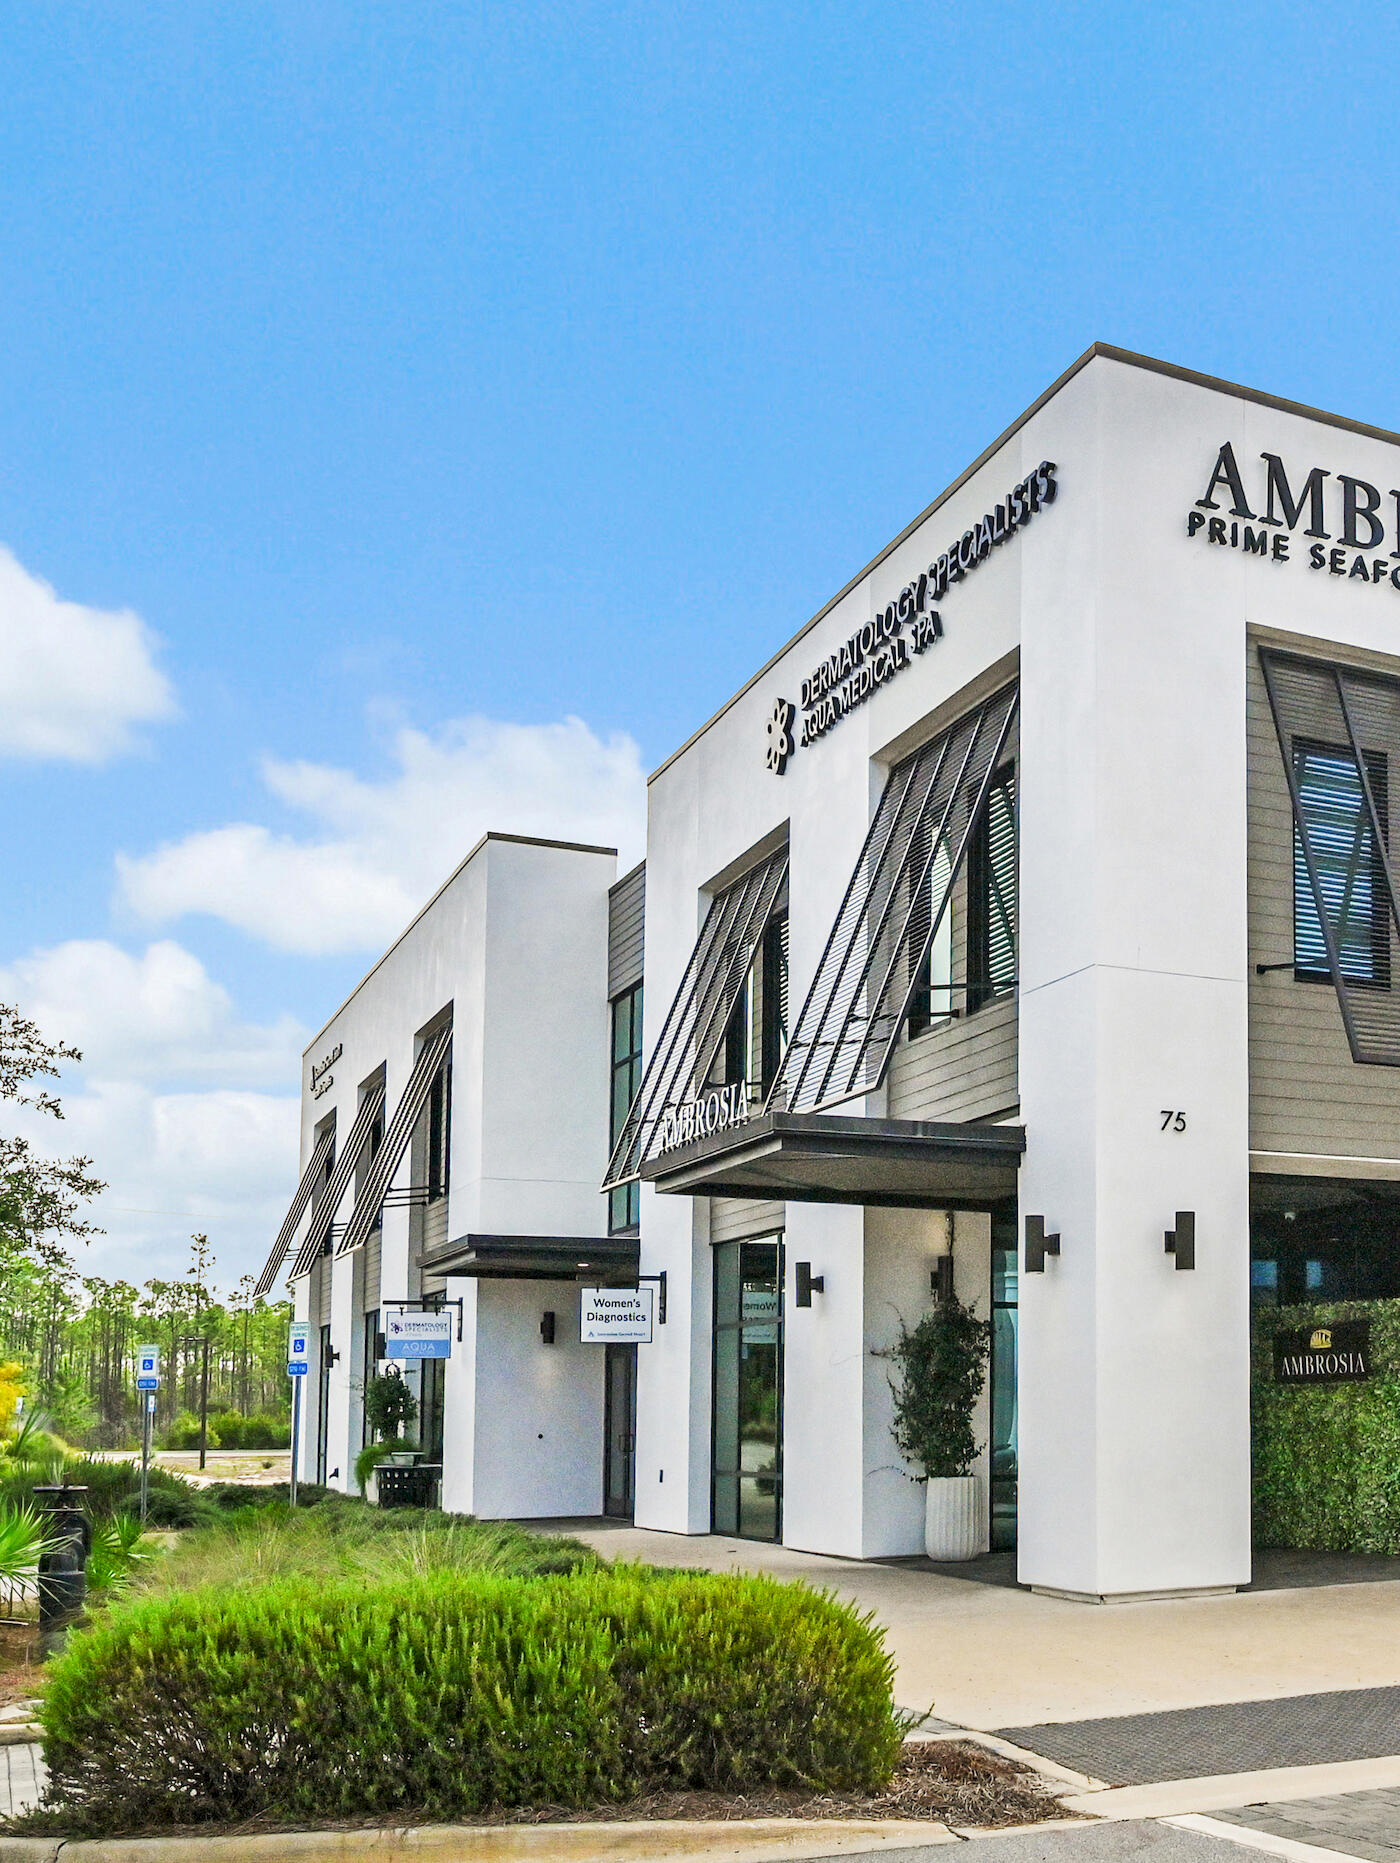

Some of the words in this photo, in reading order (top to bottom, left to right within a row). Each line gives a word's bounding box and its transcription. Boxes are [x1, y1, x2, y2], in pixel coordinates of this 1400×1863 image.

[1187, 510, 1290, 563] PRIME
[800, 573, 928, 711] DERMATOLOGY
[925, 460, 1059, 602] SPECIALISTS
[799, 695, 836, 748] AQUA
[838, 638, 912, 716] MEDICAL
[910, 610, 945, 655] SPA
[659, 1079, 750, 1153] AMBROSIA
[1160, 1110, 1187, 1132] 75
[593, 1298, 641, 1308] Women's
[587, 1312, 647, 1324] Diagnostics
[402, 1342, 436, 1353] AQUA
[1281, 1353, 1365, 1376] AMBROSIA
